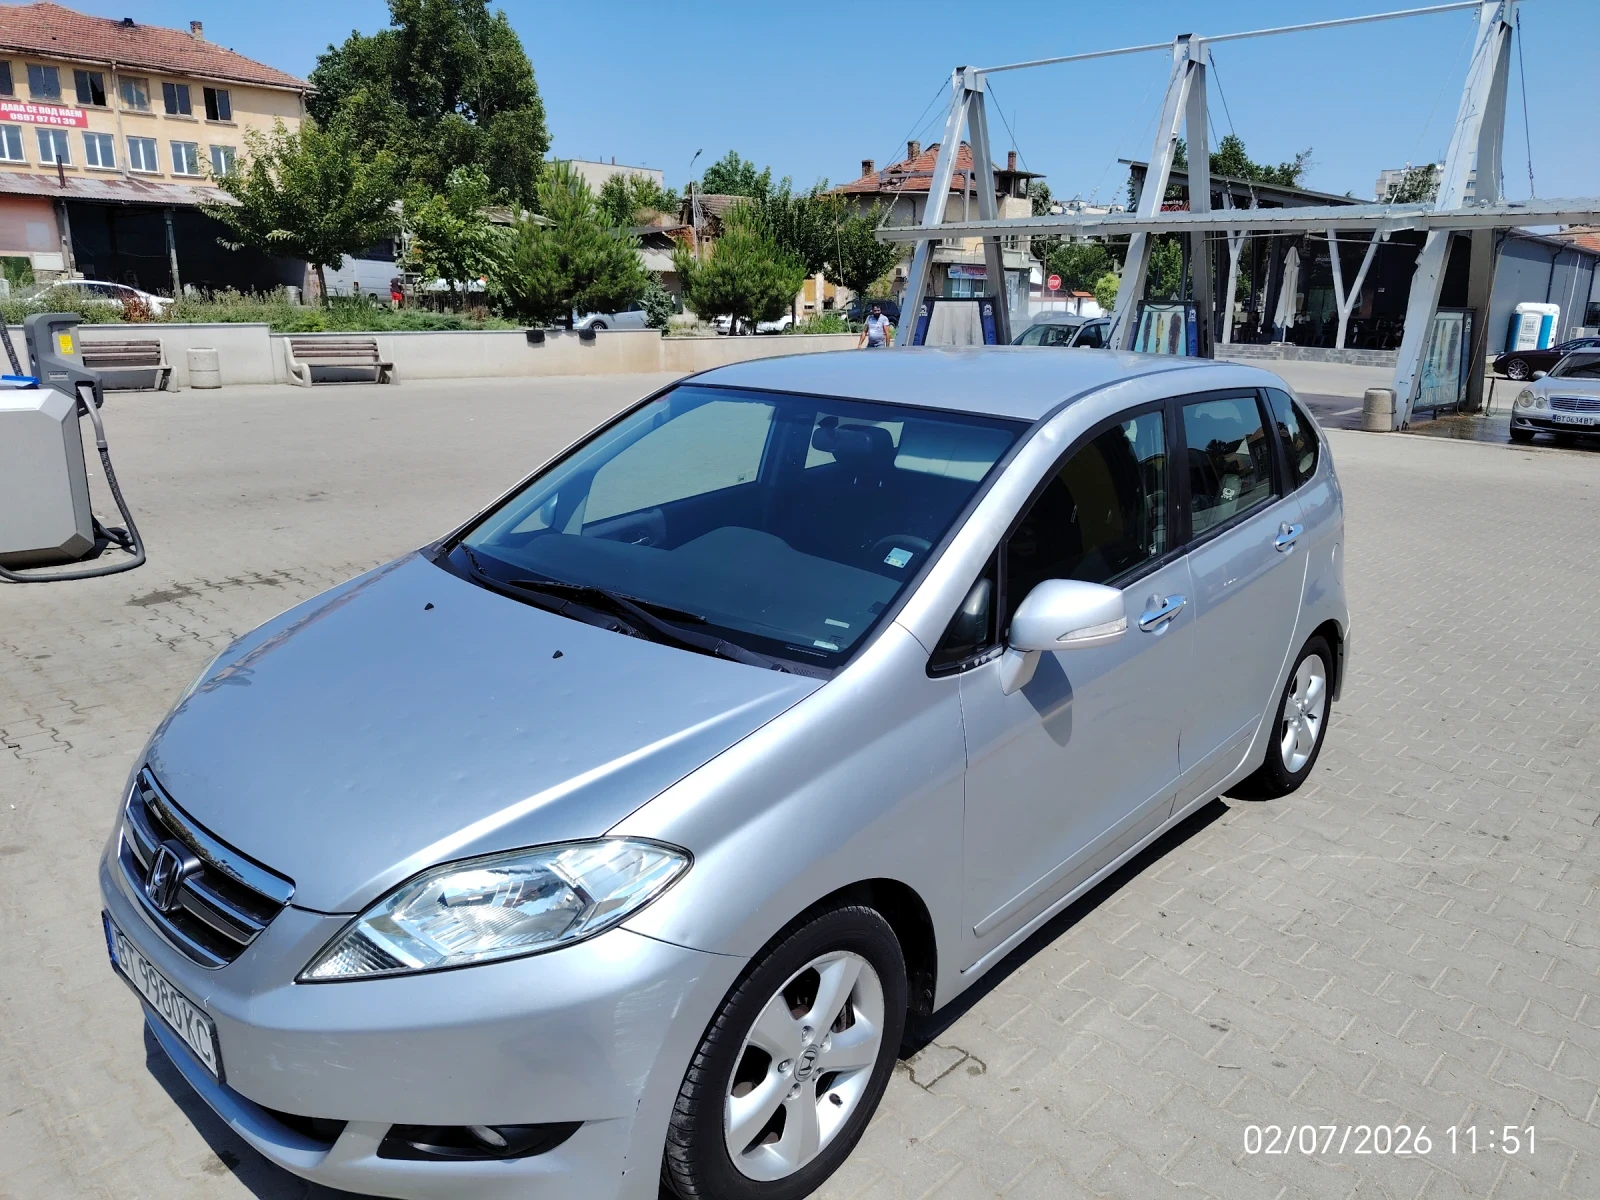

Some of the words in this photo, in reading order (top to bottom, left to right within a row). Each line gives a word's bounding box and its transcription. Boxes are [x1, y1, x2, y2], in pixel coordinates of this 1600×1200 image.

[1, 103, 25, 112] ДАВА
[26, 105, 37, 114] СЕ
[39, 107, 58, 117] ПОД
[60, 108, 83, 118] НАЕМ
[9, 113, 35, 121] 0897
[36, 115, 48, 123] 97
[115, 930, 138, 983] BT
[139, 958, 183, 1029] 9980
[183, 1001, 211, 1062] KC
